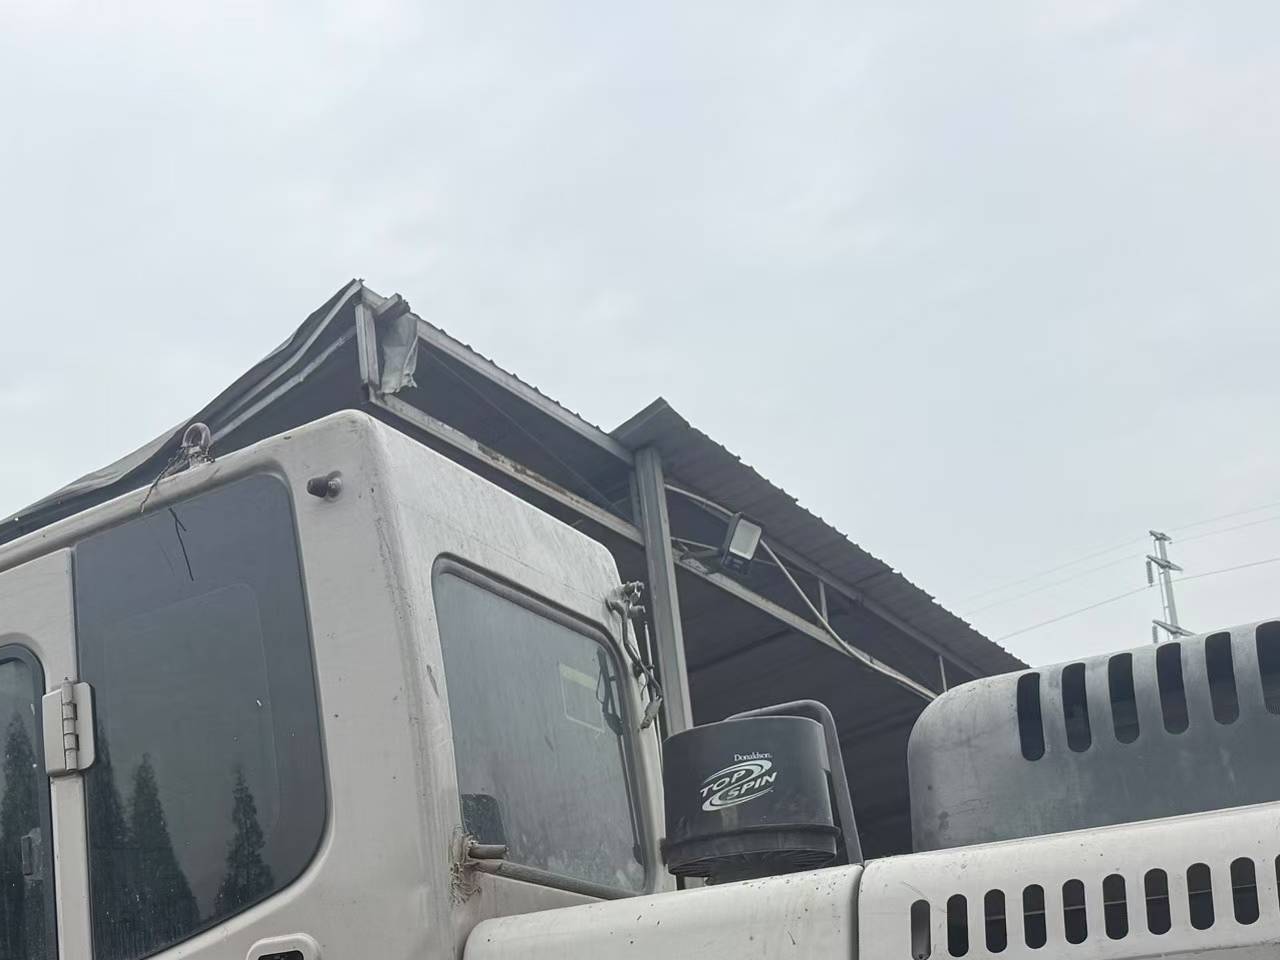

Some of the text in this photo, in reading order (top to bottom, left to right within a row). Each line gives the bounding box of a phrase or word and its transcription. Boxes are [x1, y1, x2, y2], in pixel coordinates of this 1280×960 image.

[734, 752, 771, 761] Donaldson
[700, 770, 746, 798] TOP
[727, 771, 778, 800] SPIN
